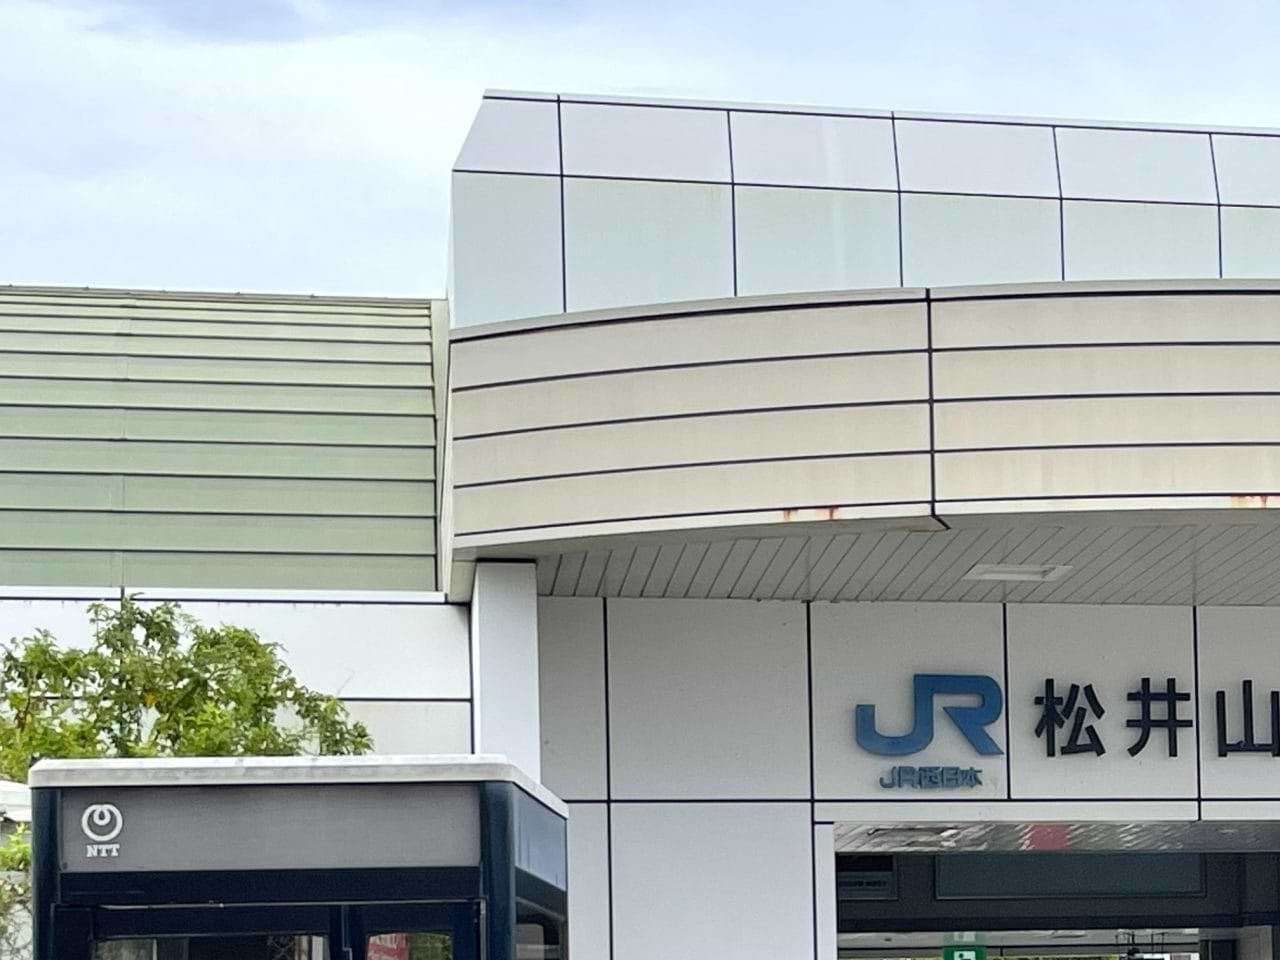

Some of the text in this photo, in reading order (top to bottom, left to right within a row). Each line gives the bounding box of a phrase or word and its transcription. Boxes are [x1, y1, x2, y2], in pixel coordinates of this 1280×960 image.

[855, 674, 1004, 756] JR
[879, 766, 983, 789] JR西日本
[86, 843, 120, 857] NTT
